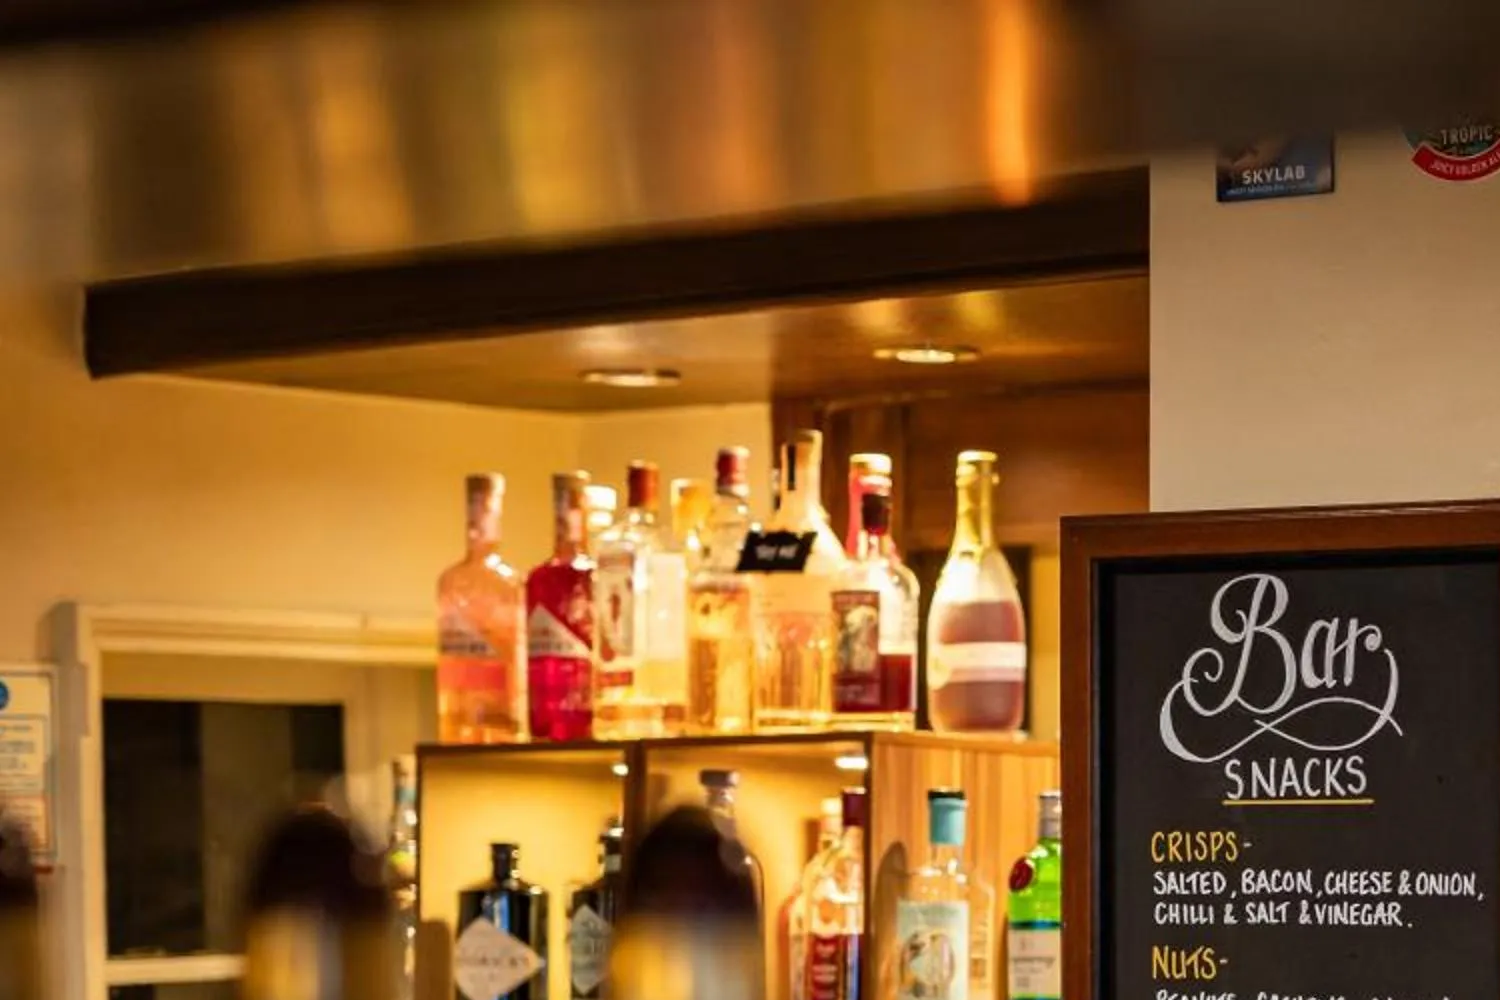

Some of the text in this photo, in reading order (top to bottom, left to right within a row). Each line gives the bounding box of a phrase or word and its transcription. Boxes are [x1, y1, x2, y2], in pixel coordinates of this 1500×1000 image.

[1441, 125, 1493, 144] TROPIC
[1242, 165, 1305, 184] SKYLAB
[1165, 574, 1398, 735] Bar
[1224, 756, 1367, 800] SNACKS
[1324, 870, 1393, 895] CHEESE
[1155, 903, 1214, 925] CHILLI
[1223, 902, 1238, 925] &
[1245, 901, 1291, 924] SALT
